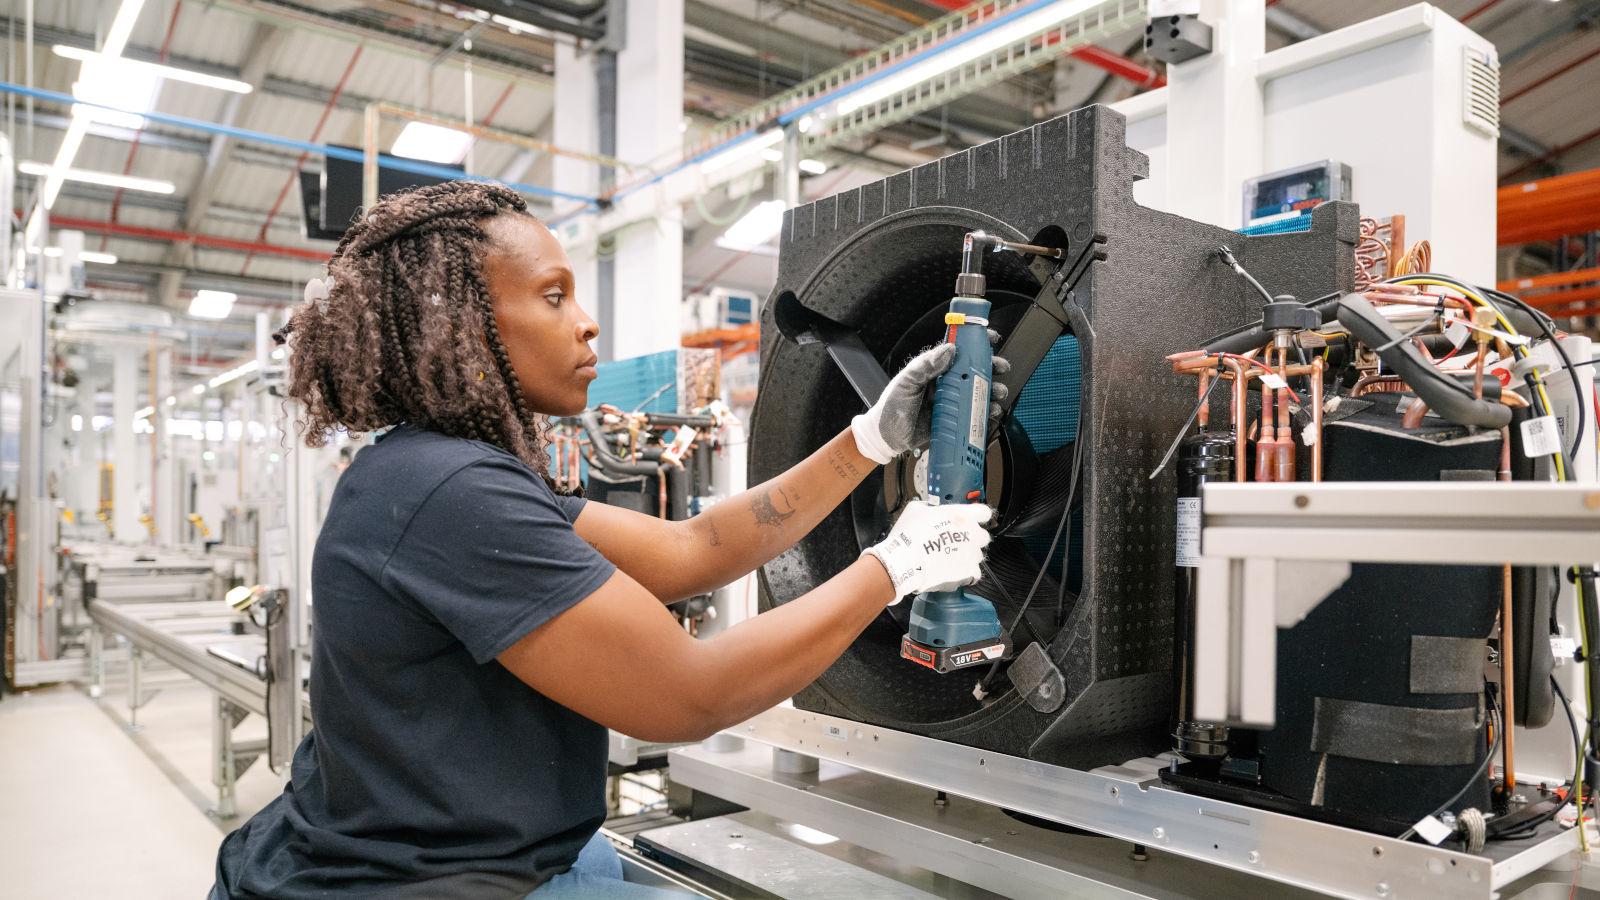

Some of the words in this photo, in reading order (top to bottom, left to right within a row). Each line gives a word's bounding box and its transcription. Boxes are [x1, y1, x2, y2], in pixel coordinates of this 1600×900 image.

[1293, 198, 1322, 211] BOSCH
[923, 530, 970, 555] HyFlex
[956, 653, 972, 665] 18V
